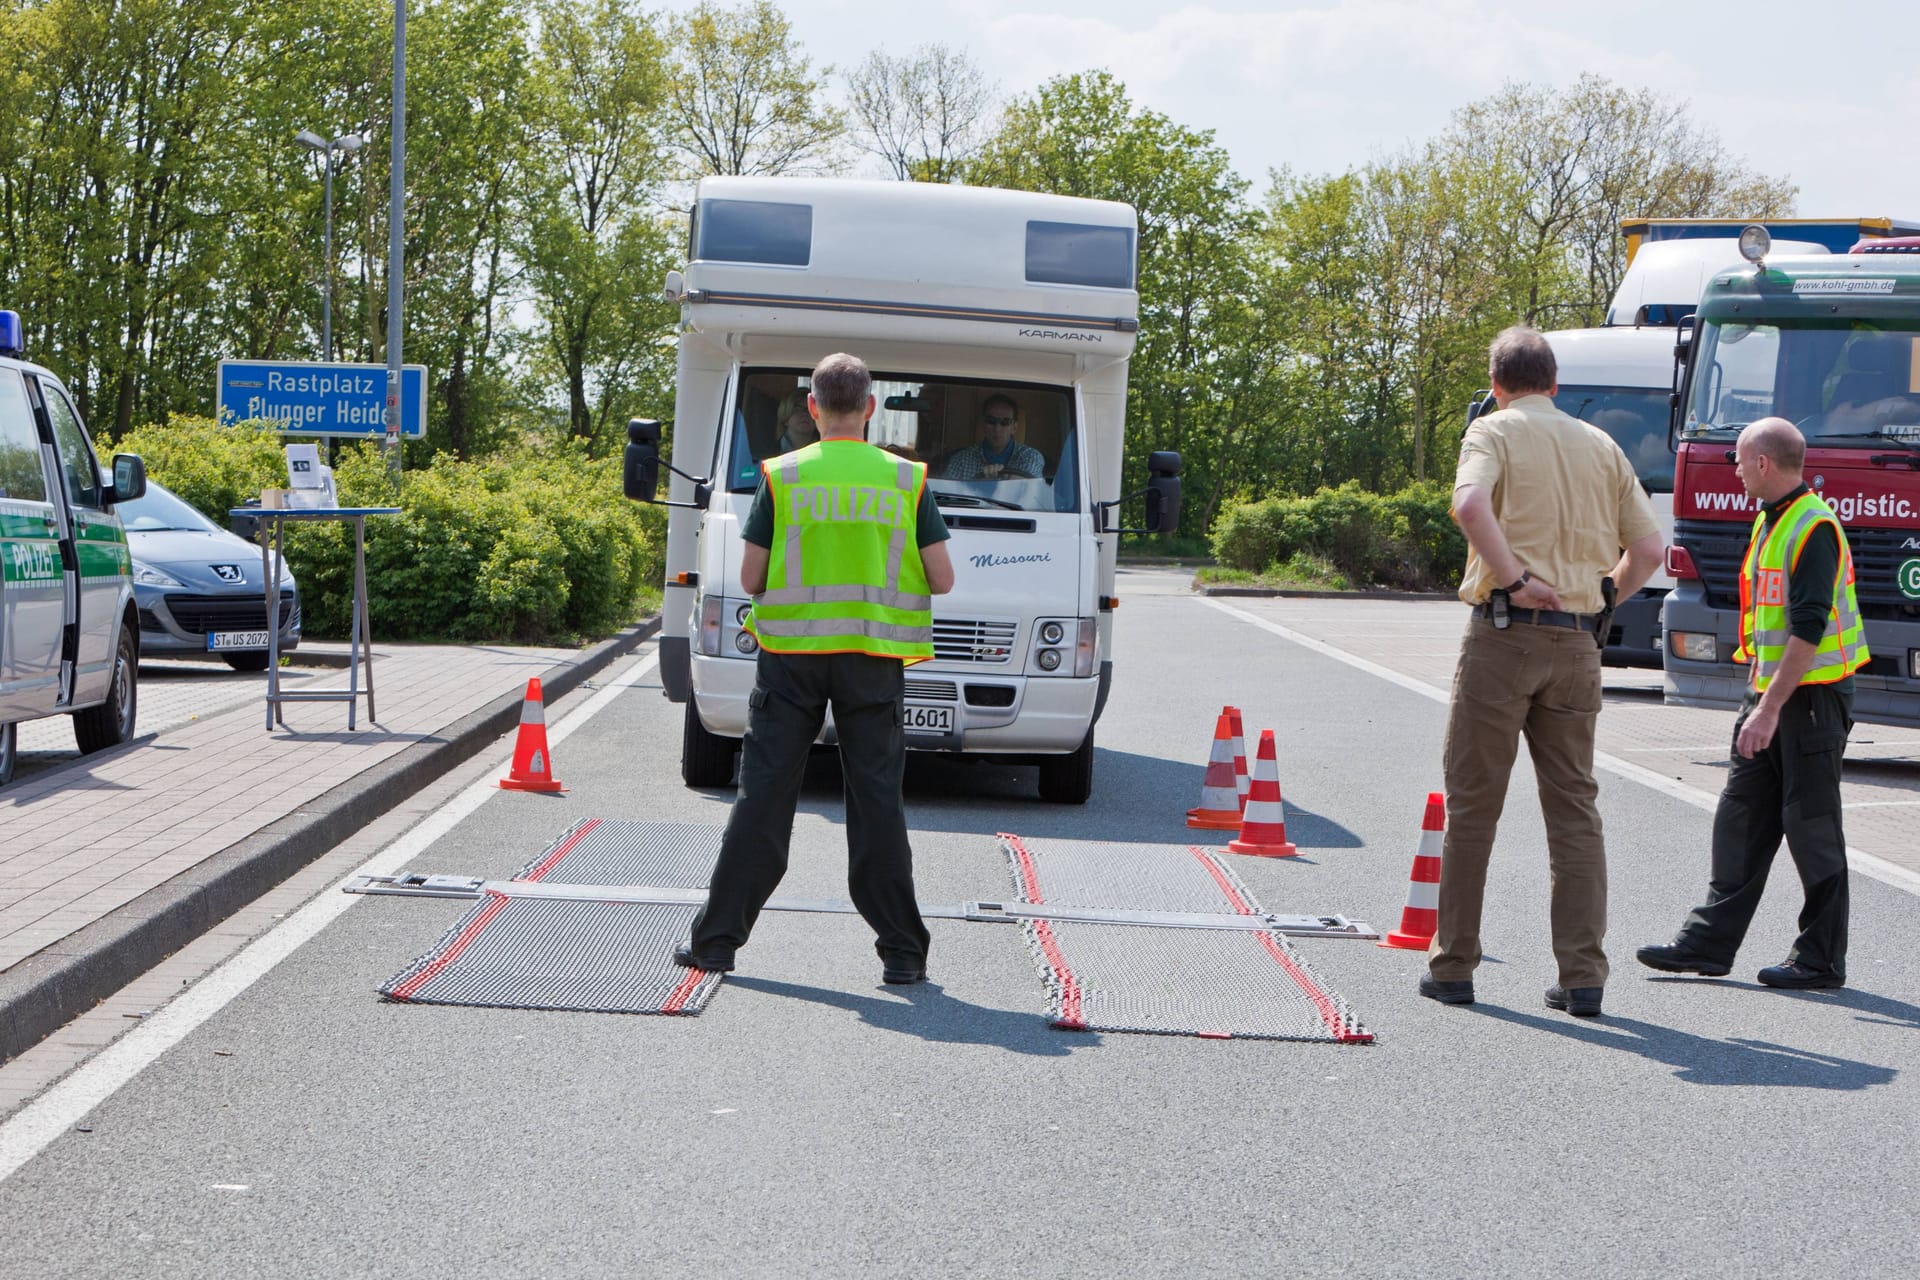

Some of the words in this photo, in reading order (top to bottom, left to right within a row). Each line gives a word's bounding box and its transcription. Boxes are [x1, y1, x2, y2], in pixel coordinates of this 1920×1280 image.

[1795, 281, 1896, 292] www.kohl-gmbh.de
[1018, 328, 1102, 343] KARMANN
[268, 371, 374, 398] Rastplatz
[791, 486, 904, 526] POLIZEI
[12, 542, 54, 579] POLIZEI
[969, 552, 1051, 568] Missouri
[215, 634, 227, 646] ST
[232, 633, 245, 646] US
[246, 632, 268, 646] 2072
[904, 708, 950, 729] 1601
